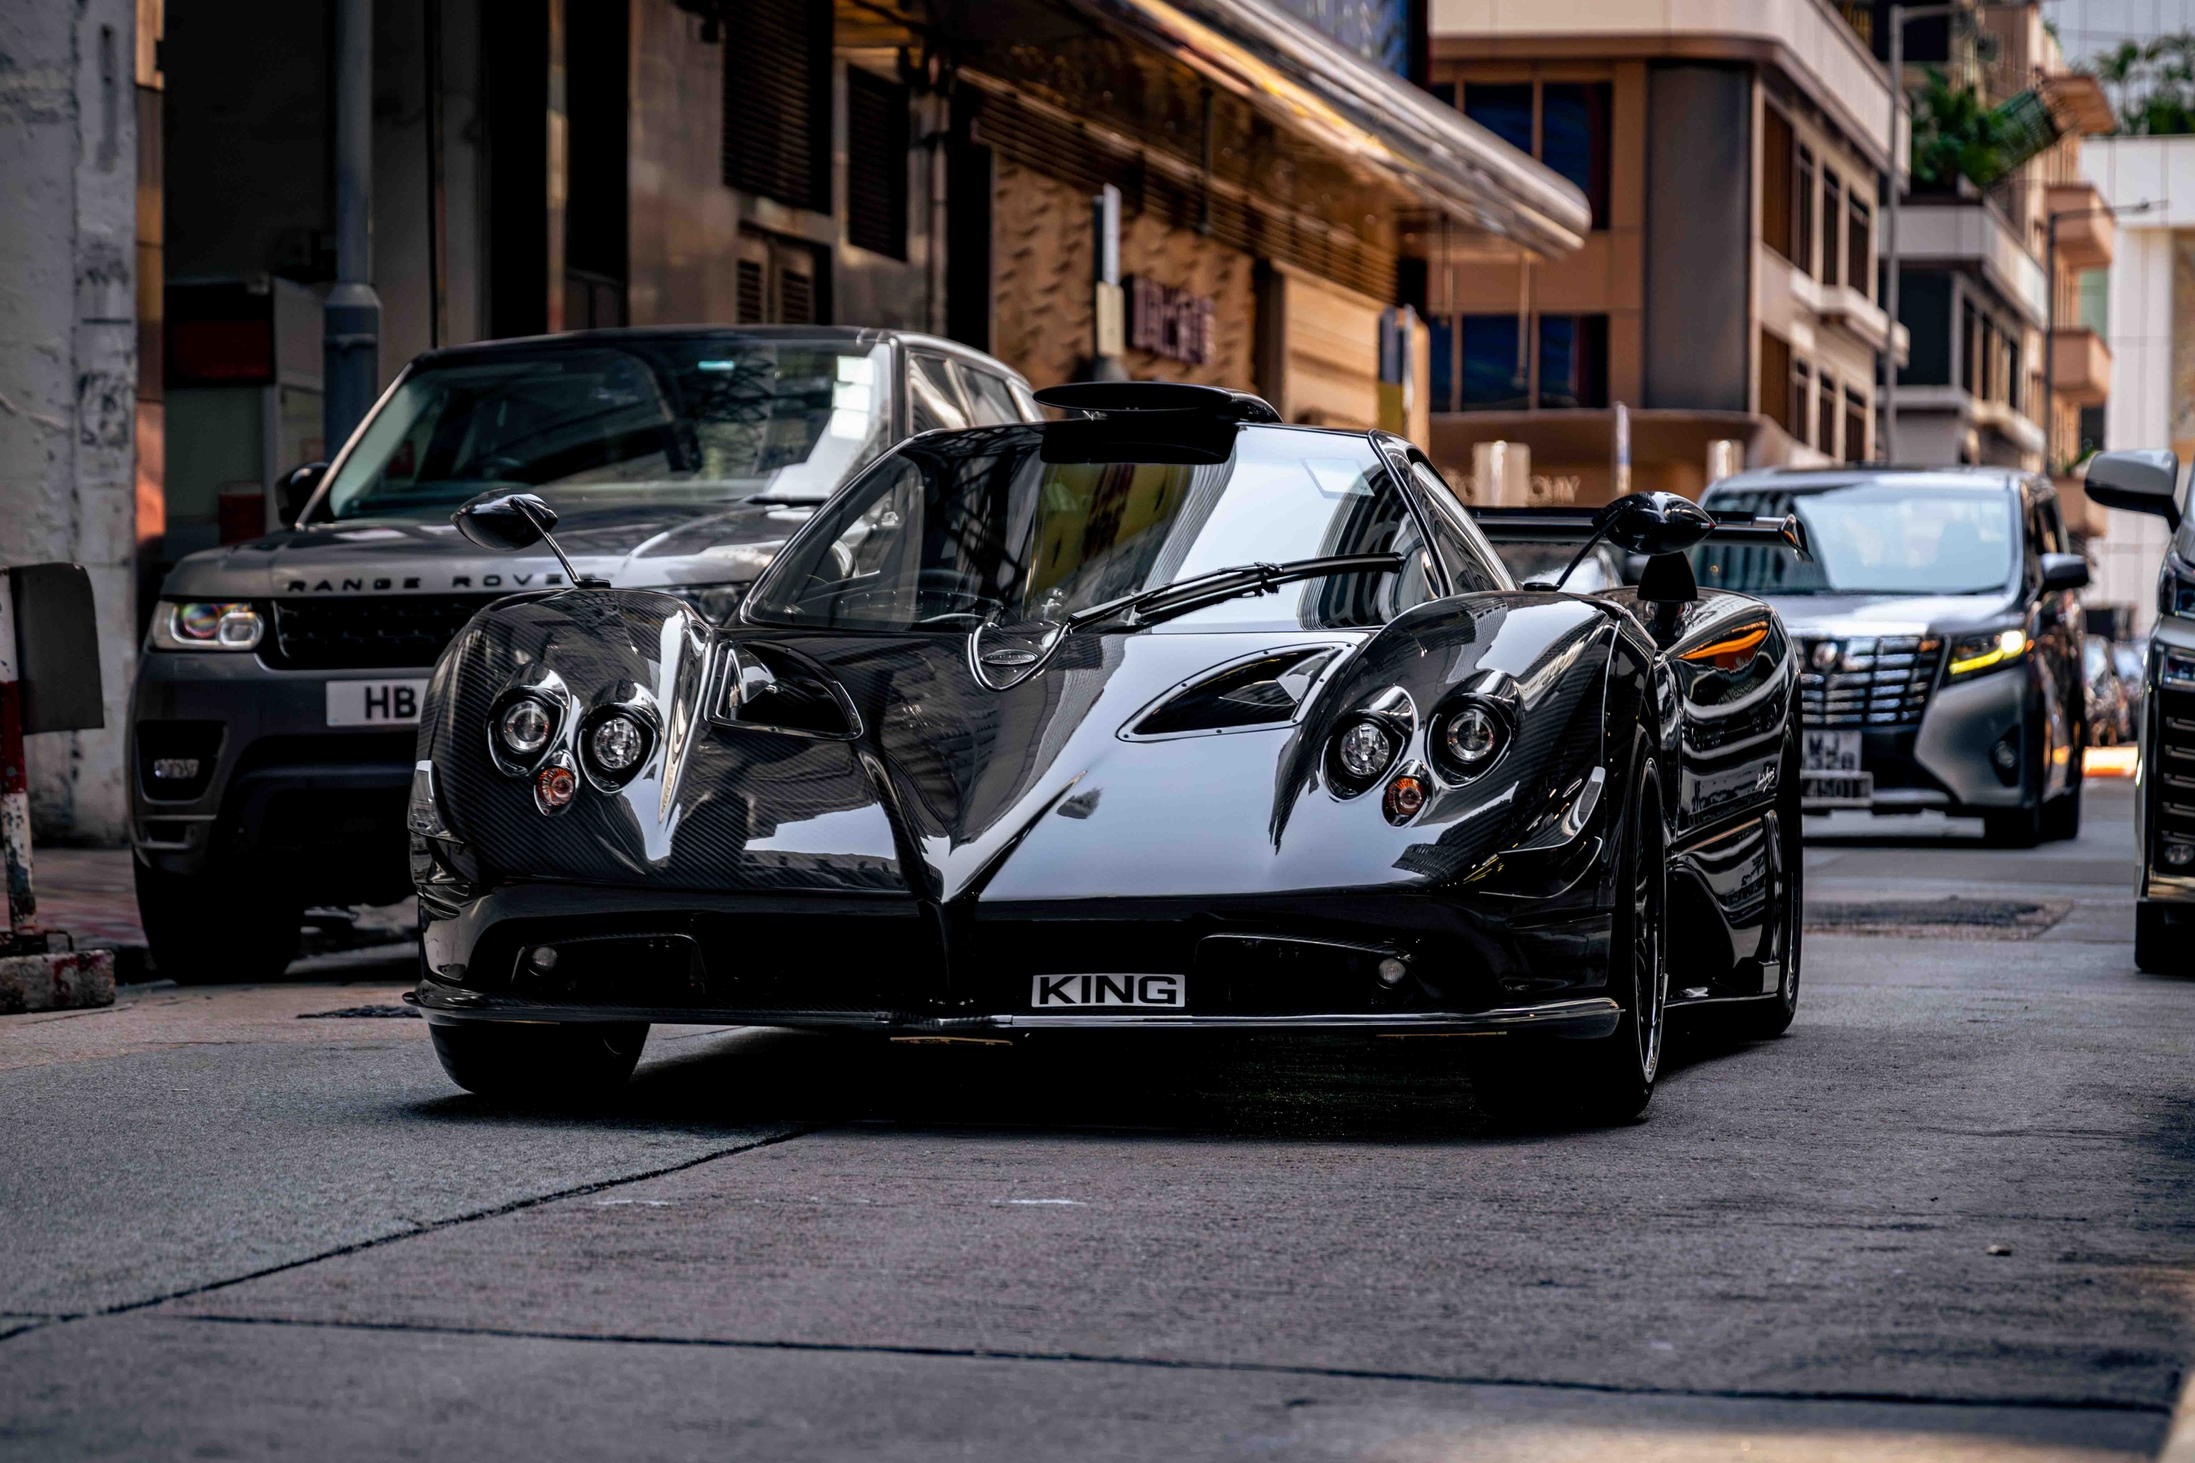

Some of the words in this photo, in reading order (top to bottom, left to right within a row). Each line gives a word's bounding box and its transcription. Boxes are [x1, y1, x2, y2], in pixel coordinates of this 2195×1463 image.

[287, 577, 422, 592] RANGE
[365, 686, 416, 719] HB
[1039, 975, 1177, 1004] KING
